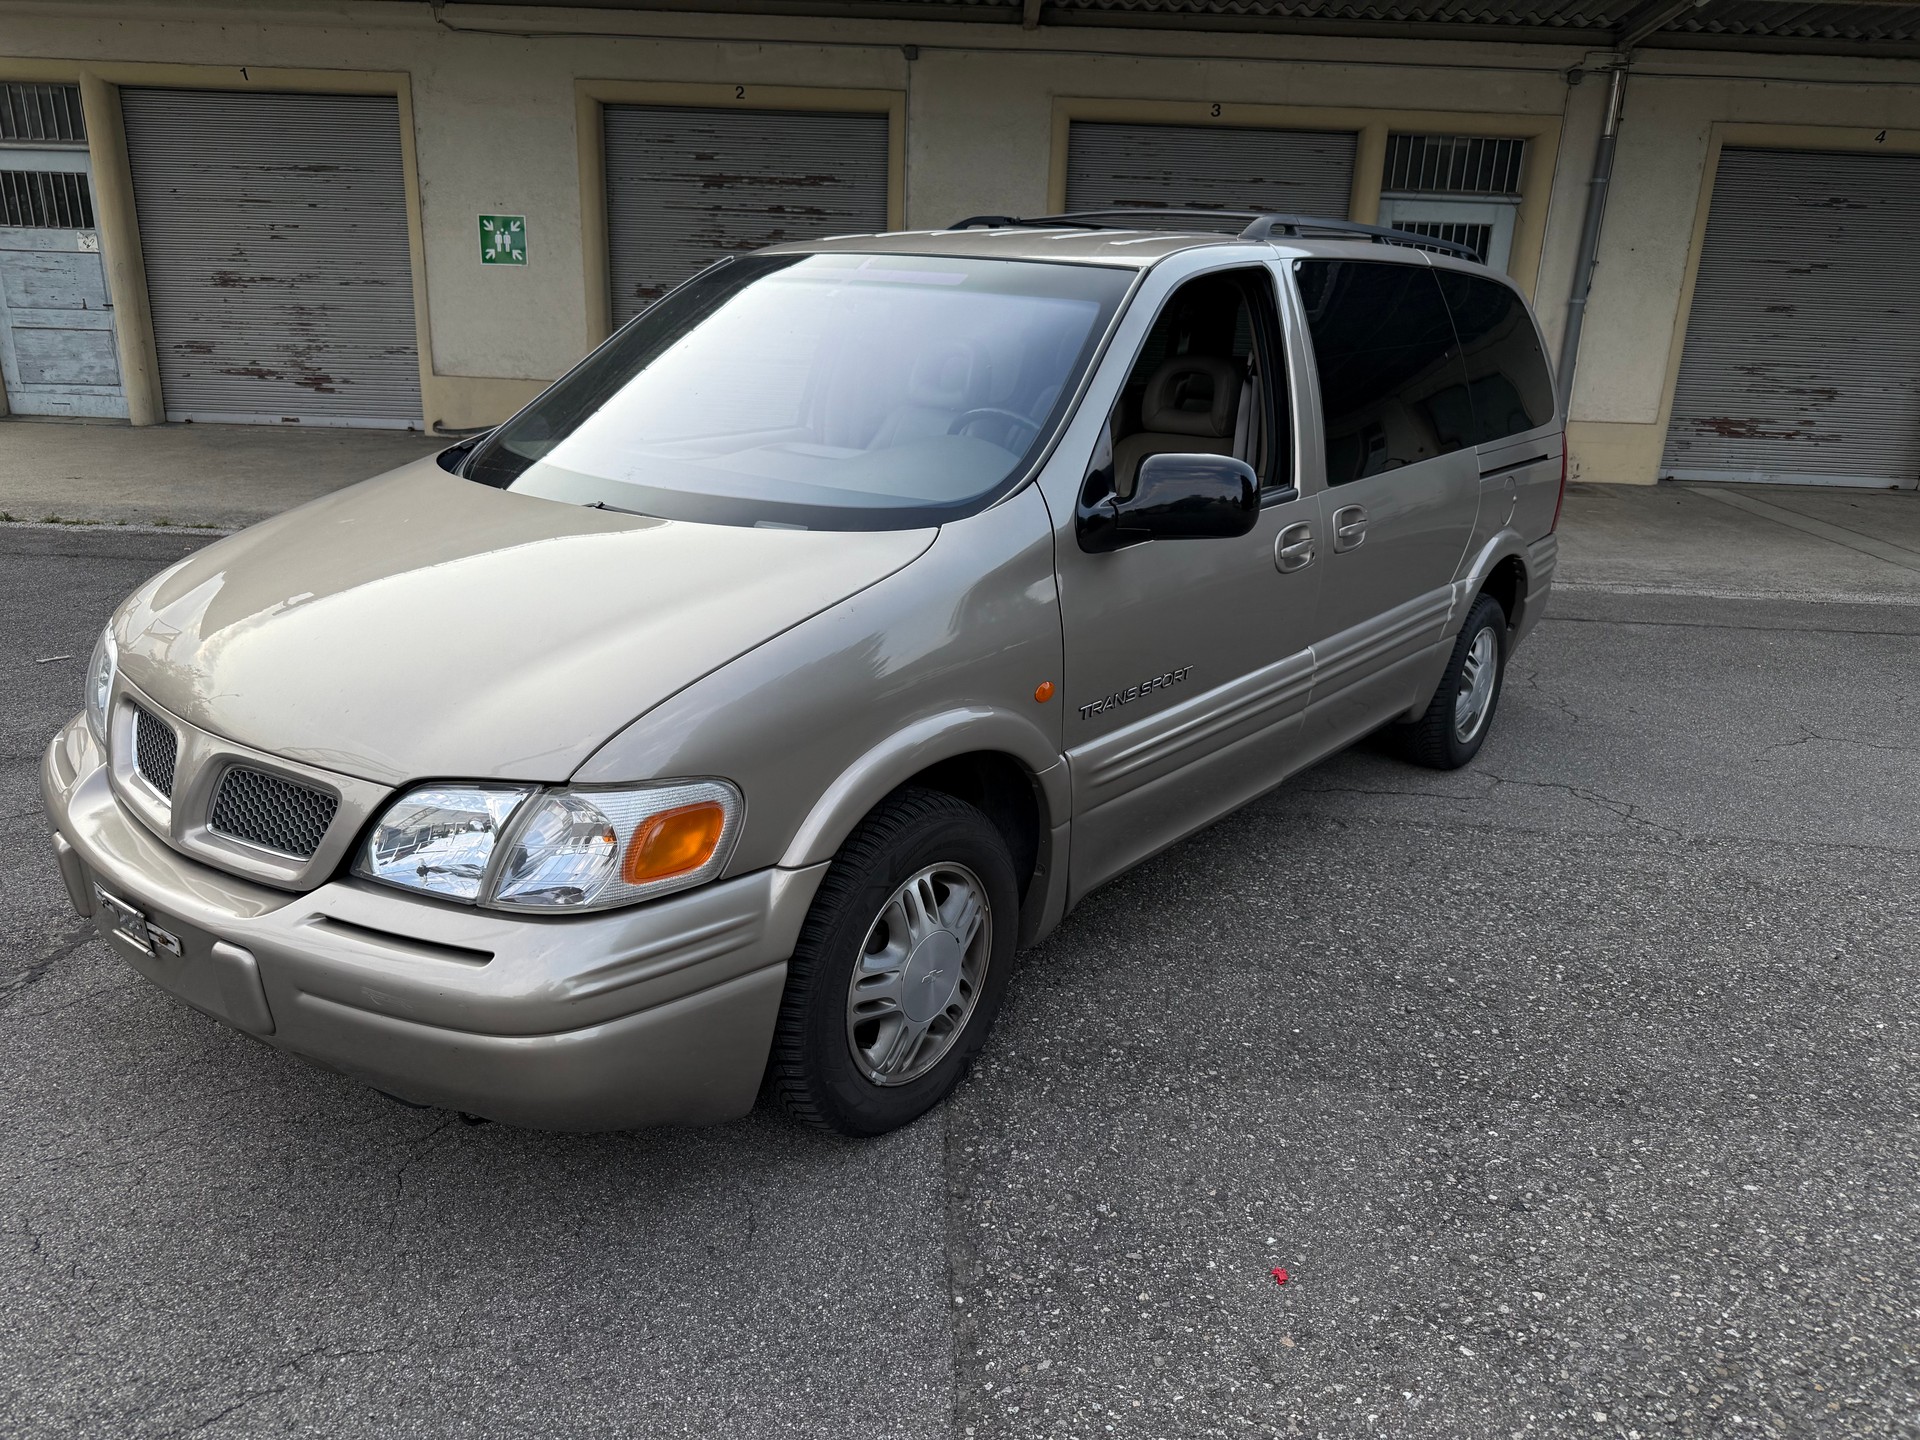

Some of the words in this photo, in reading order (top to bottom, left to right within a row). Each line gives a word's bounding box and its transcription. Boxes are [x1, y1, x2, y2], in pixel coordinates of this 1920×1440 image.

[240, 67, 249, 81] 1
[735, 85, 746, 99] 2
[1210, 103, 1222, 117] 3
[1874, 129, 1887, 144] 4
[1079, 687, 1138, 720] TRANS
[1139, 664, 1194, 697] SPORT
